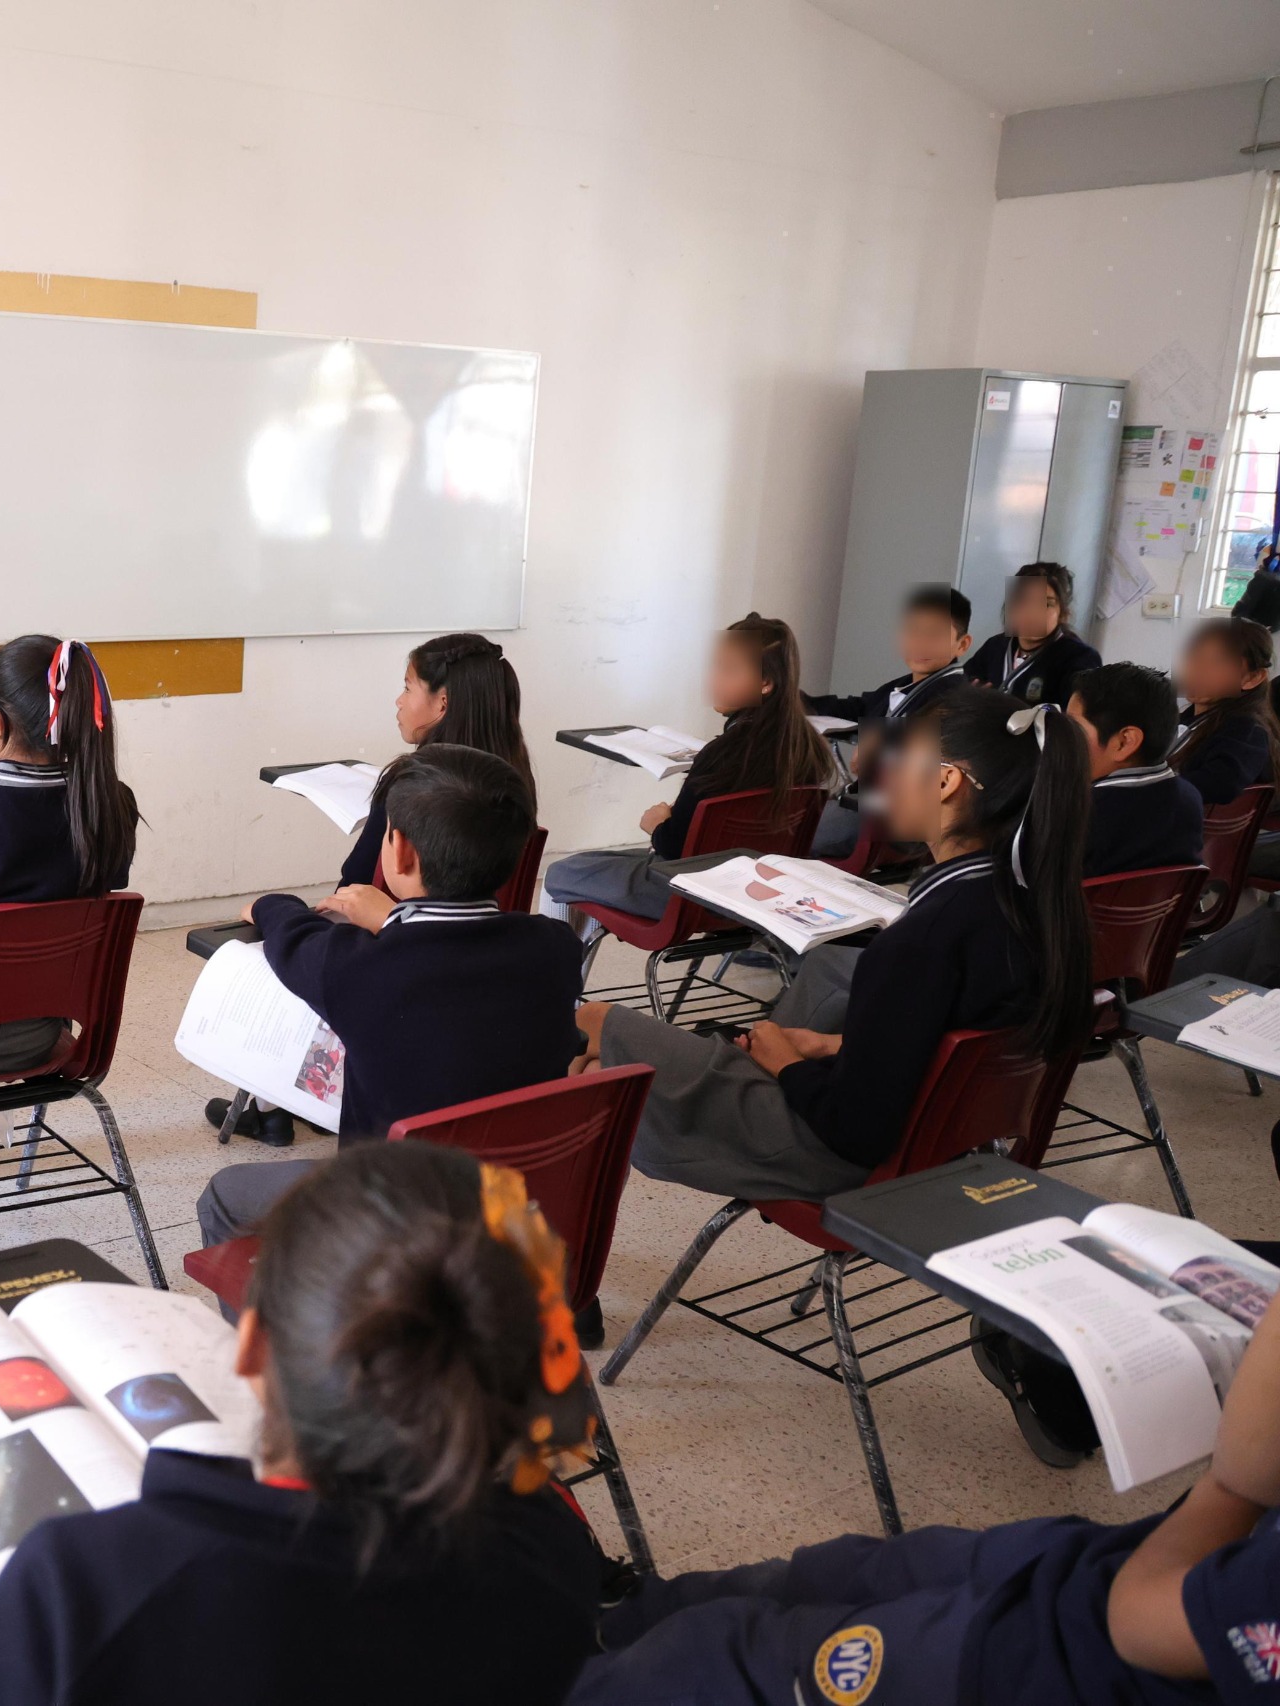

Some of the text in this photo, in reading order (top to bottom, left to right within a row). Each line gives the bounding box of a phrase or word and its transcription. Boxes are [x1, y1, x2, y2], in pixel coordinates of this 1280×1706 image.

[993, 1247, 1066, 1273] telón
[1, 1270, 68, 1290] PEMEX
[833, 1641, 871, 1689] NYC
